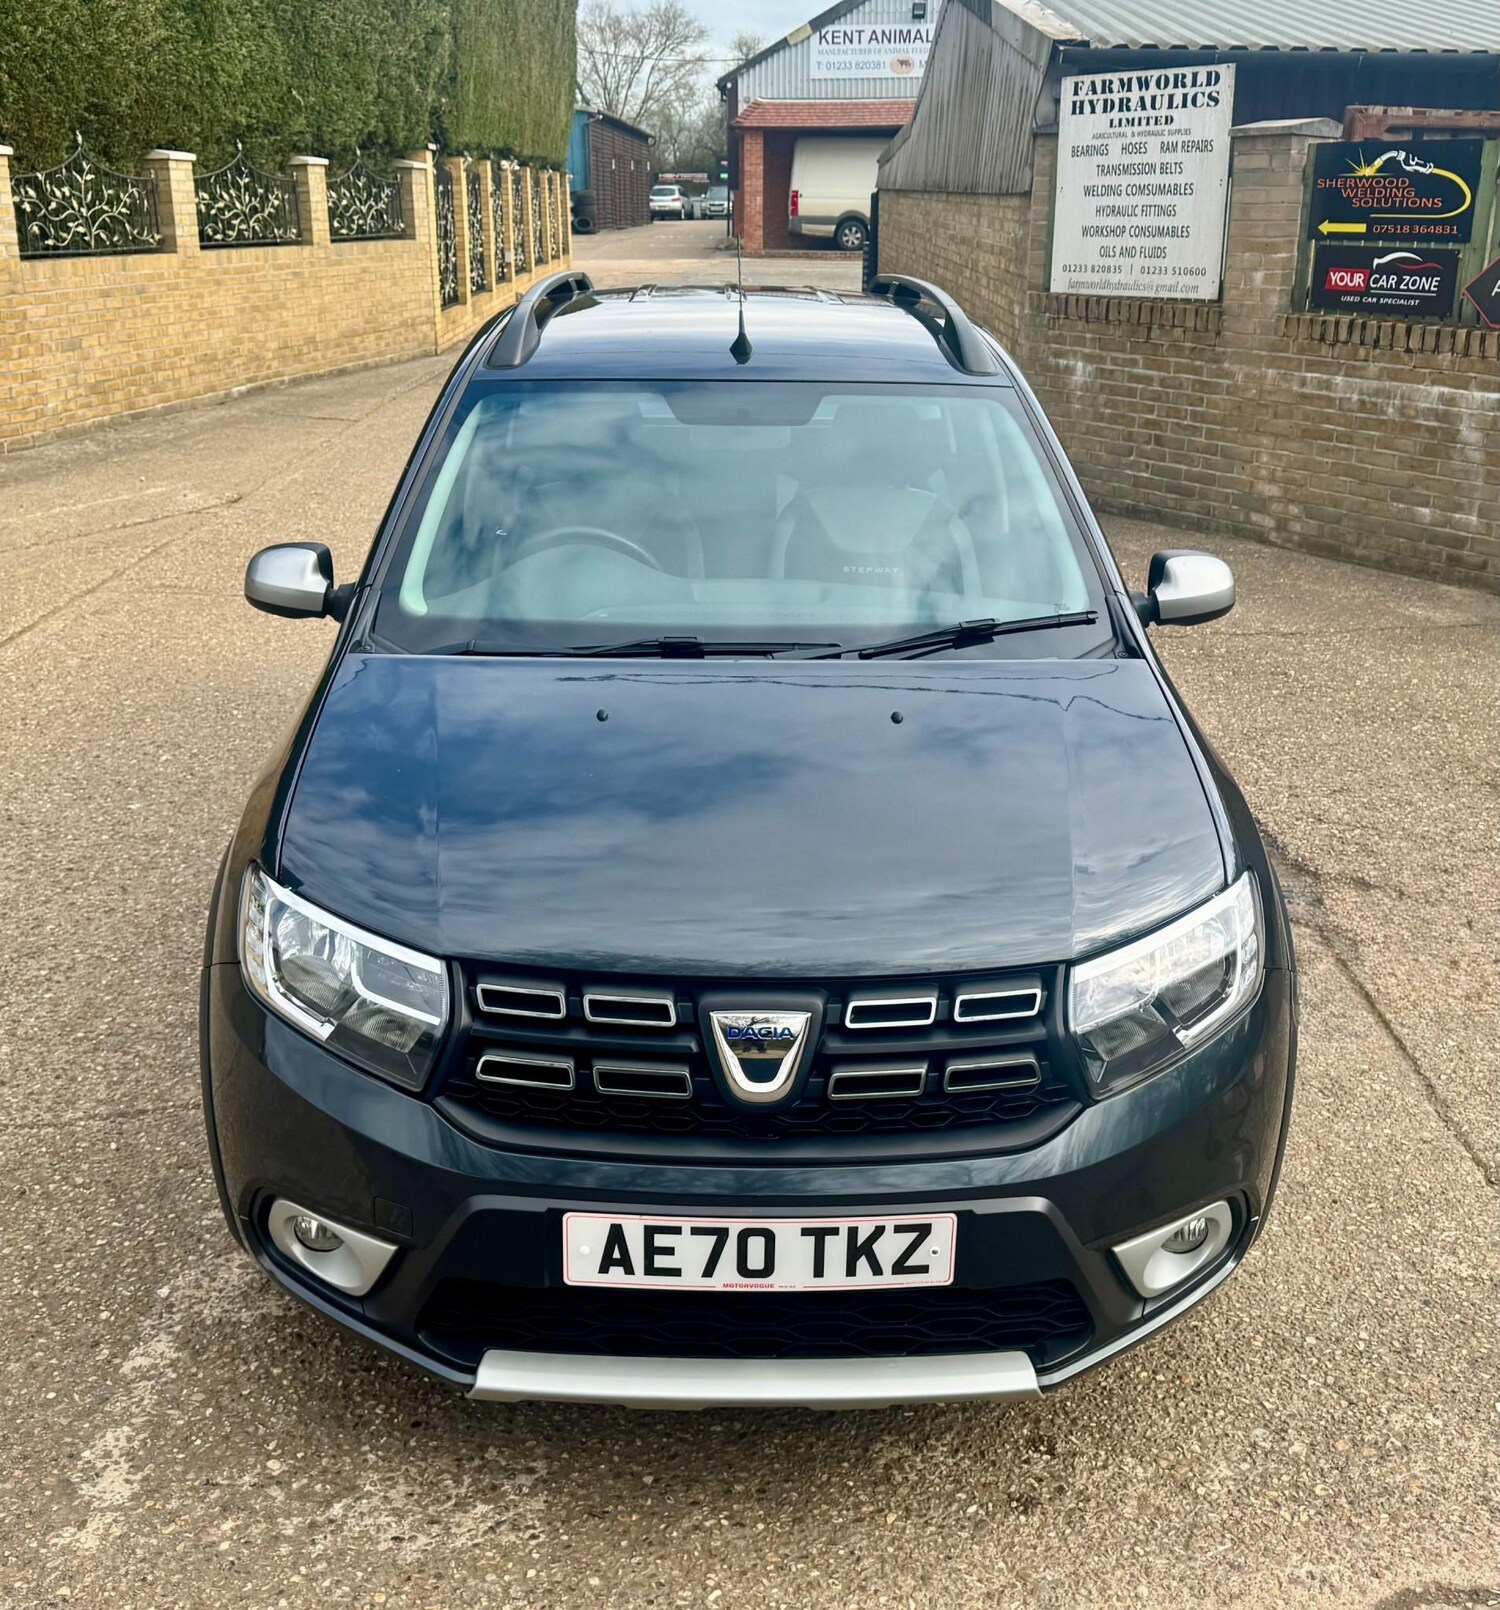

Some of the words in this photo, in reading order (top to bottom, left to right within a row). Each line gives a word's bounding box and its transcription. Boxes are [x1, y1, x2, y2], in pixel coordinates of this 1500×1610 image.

[819, 29, 865, 45] KENT
[868, 28, 933, 44] ANIMAL
[817, 47, 871, 56] MANUFACTURER
[873, 47, 884, 55] OF
[884, 47, 910, 55] ANIMAL
[825, 61, 852, 70] 01233
[854, 61, 886, 70] 820381
[1072, 70, 1221, 97] FARMWORLD
[1071, 90, 1220, 115] HYDRAULICS
[1109, 114, 1174, 129] LIMITED
[1092, 131, 1128, 140] AGRICULTURAL
[1130, 130, 1136, 138] &
[1137, 129, 1166, 138] HYDRAULIC
[1167, 128, 1192, 136] SUPPLIES
[1071, 143, 1109, 158] BEARINGS
[1121, 141, 1148, 156] HOSES
[1160, 140, 1179, 154] RAM
[1180, 139, 1214, 154] REPAIRS
[1096, 163, 1157, 177] TRANSMISSION
[1159, 161, 1184, 175] BELTS
[1083, 184, 1122, 197] WELDING
[1125, 182, 1194, 197] COMSUMABLES
[1317, 178, 1409, 188] SHERWOOD
[1341, 188, 1415, 198] WELDING
[1352, 198, 1442, 208] SOLUTIONS
[1095, 204, 1139, 217] HYDRAULIC
[1141, 204, 1177, 217] FITTINGS
[1082, 225, 1126, 238] WORKSHOP
[1129, 225, 1190, 238] CONSUMABLES
[1372, 225, 1410, 234] 07518
[1411, 225, 1458, 235] 364831
[1099, 245, 1116, 258] OILS
[1119, 246, 1137, 258] AND
[1140, 246, 1167, 259] FLUIDS
[1062, 264, 1088, 273] 01233
[1090, 264, 1122, 274] 820835
[1140, 265, 1168, 275] 01233
[1171, 266, 1207, 277] 510600
[1068, 277, 1199, 295] farmworldhydraulics@gmail.com
[1329, 271, 1365, 287] YOUR
[1369, 273, 1397, 289] CAR
[1400, 276, 1441, 292] ZONE
[1341, 295, 1360, 303] USED
[1379, 297, 1420, 306] SPECIALIST
[727, 1026, 794, 1040] DACIA
[597, 1223, 776, 1279] AE70
[800, 1223, 933, 1278] TKZ
